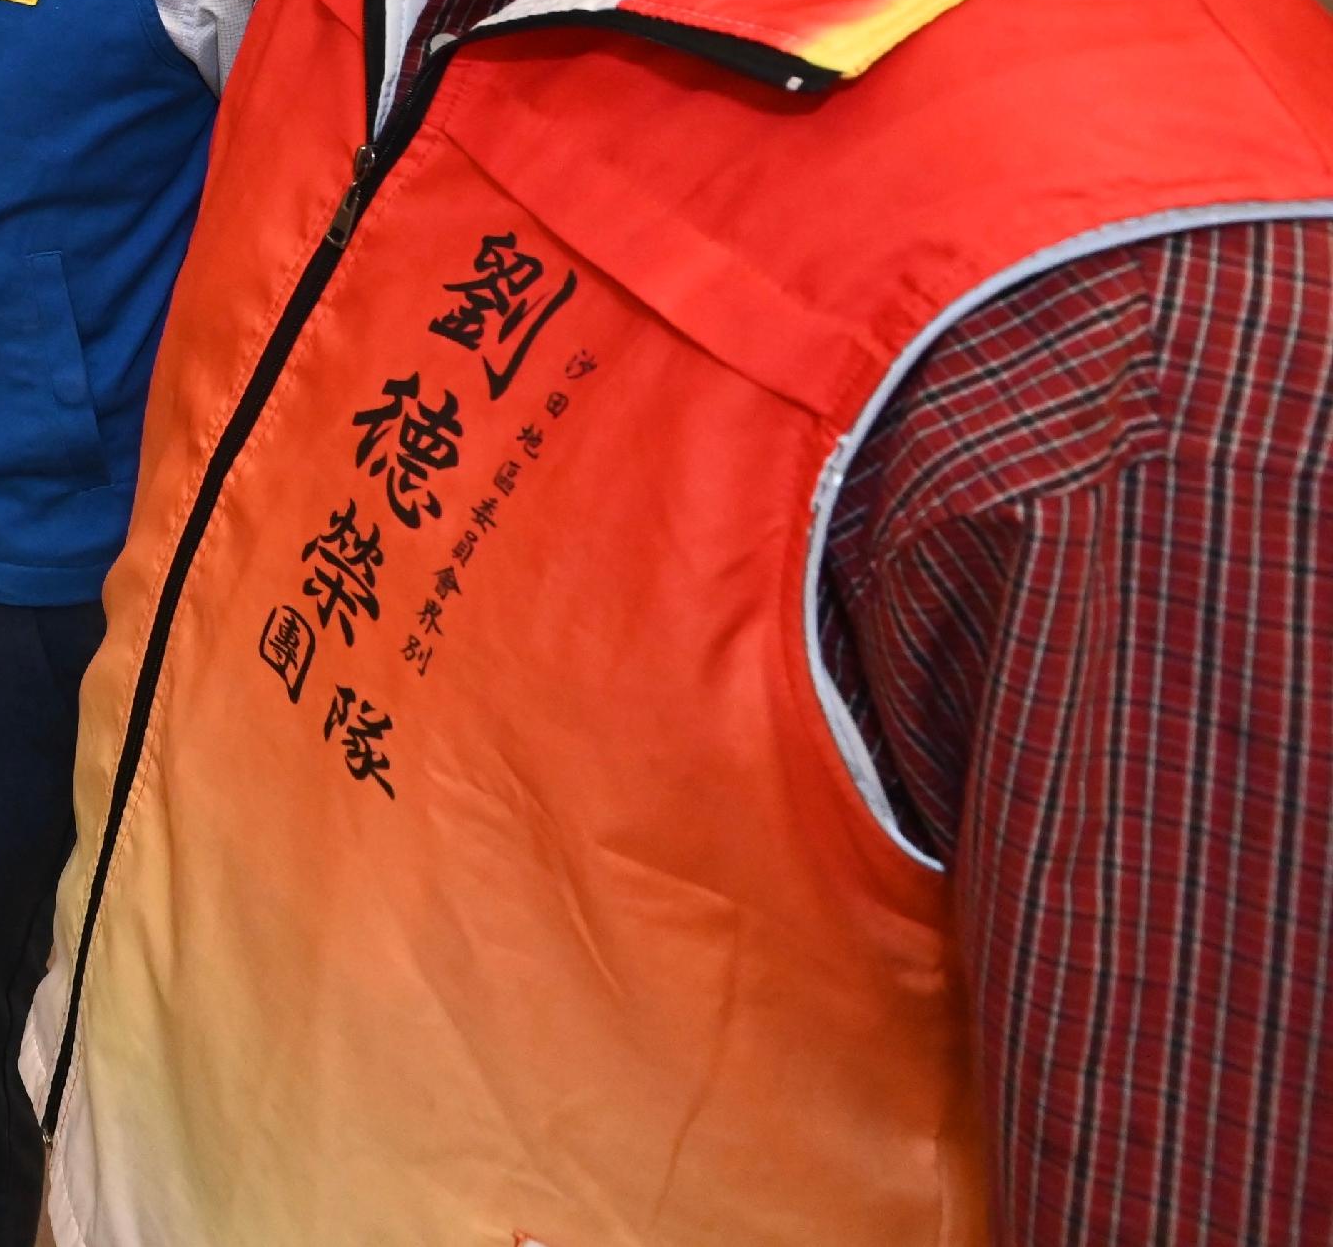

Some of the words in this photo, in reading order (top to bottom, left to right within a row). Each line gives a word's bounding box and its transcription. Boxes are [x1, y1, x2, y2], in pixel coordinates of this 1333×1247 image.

[301, 231, 578, 648] 劉德榮
[400, 350, 597, 676] 沙田地區委員會界別
